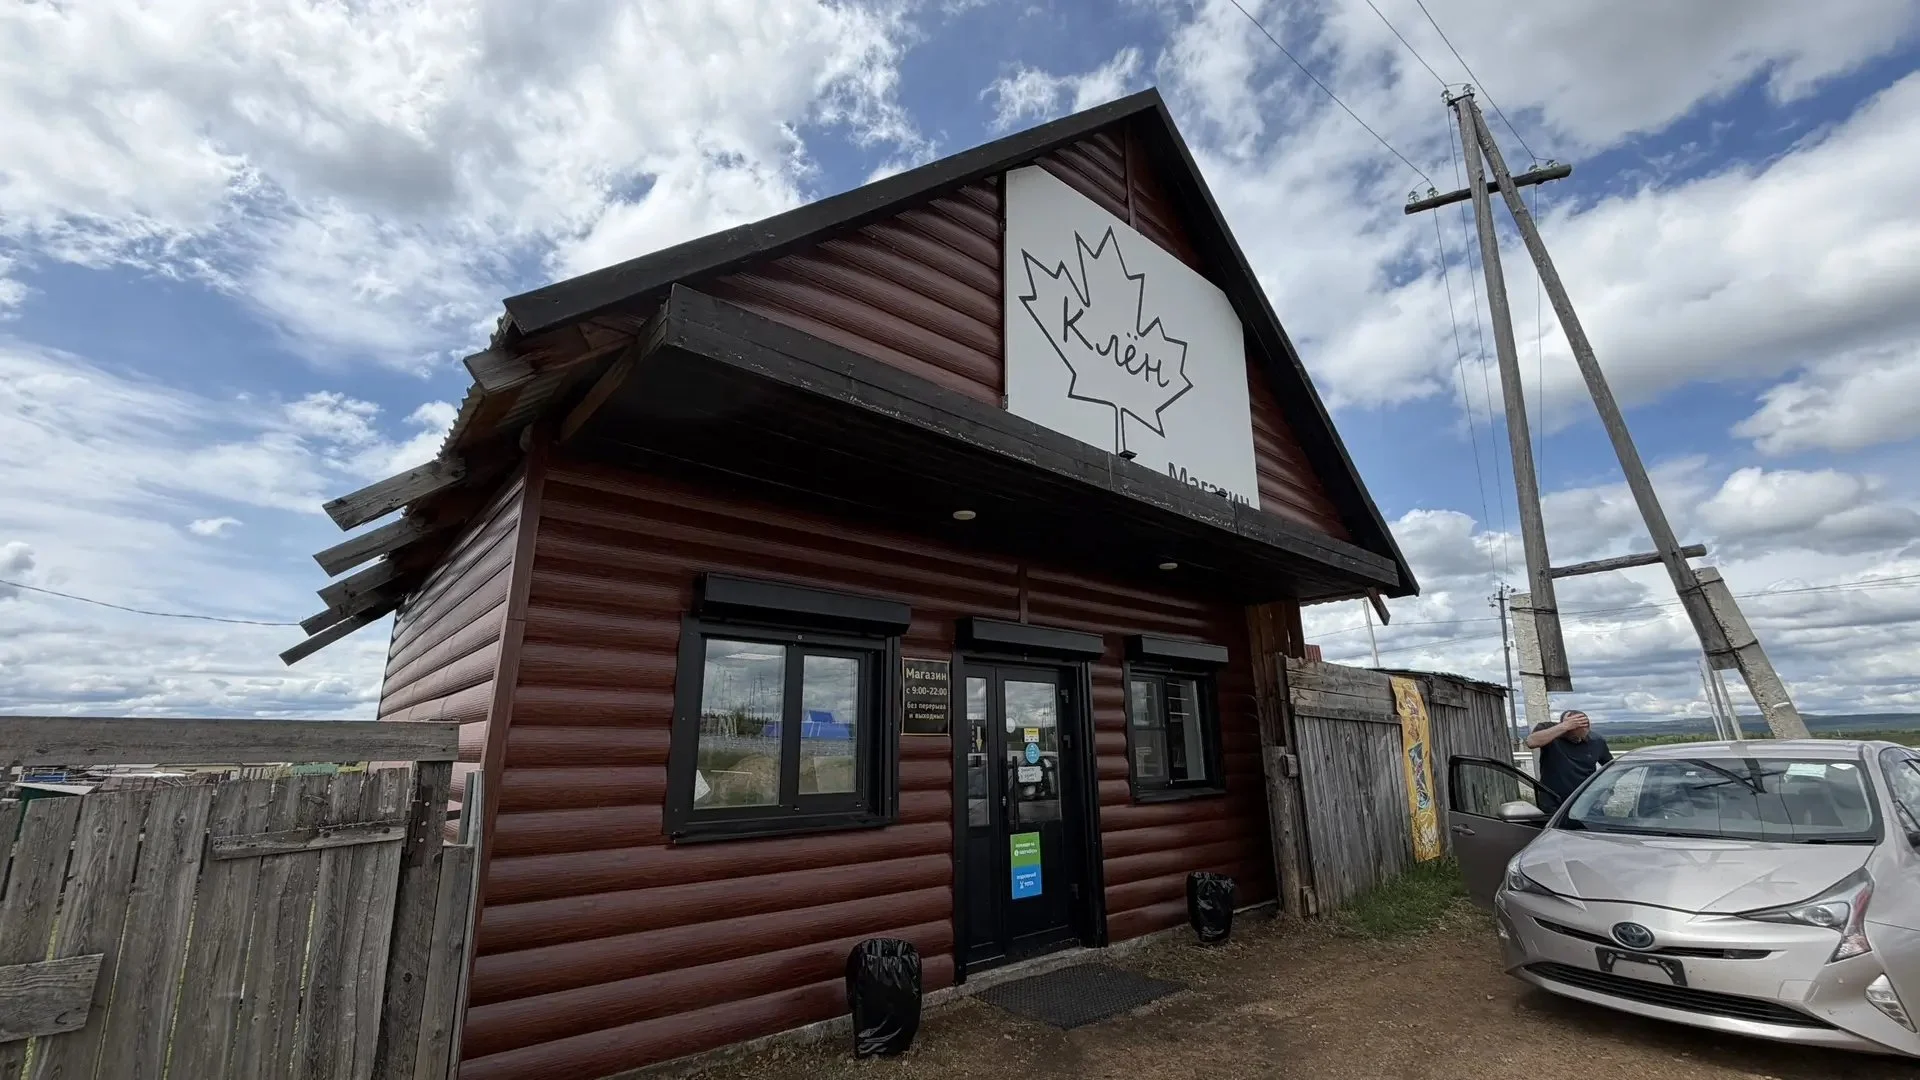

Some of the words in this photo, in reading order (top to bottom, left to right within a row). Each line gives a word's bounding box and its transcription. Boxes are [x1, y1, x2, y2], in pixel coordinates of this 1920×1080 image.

[1063, 295, 1170, 388] Клён
[906, 668, 946, 680] Магазин
[912, 686, 947, 696] 9:00-22:00
